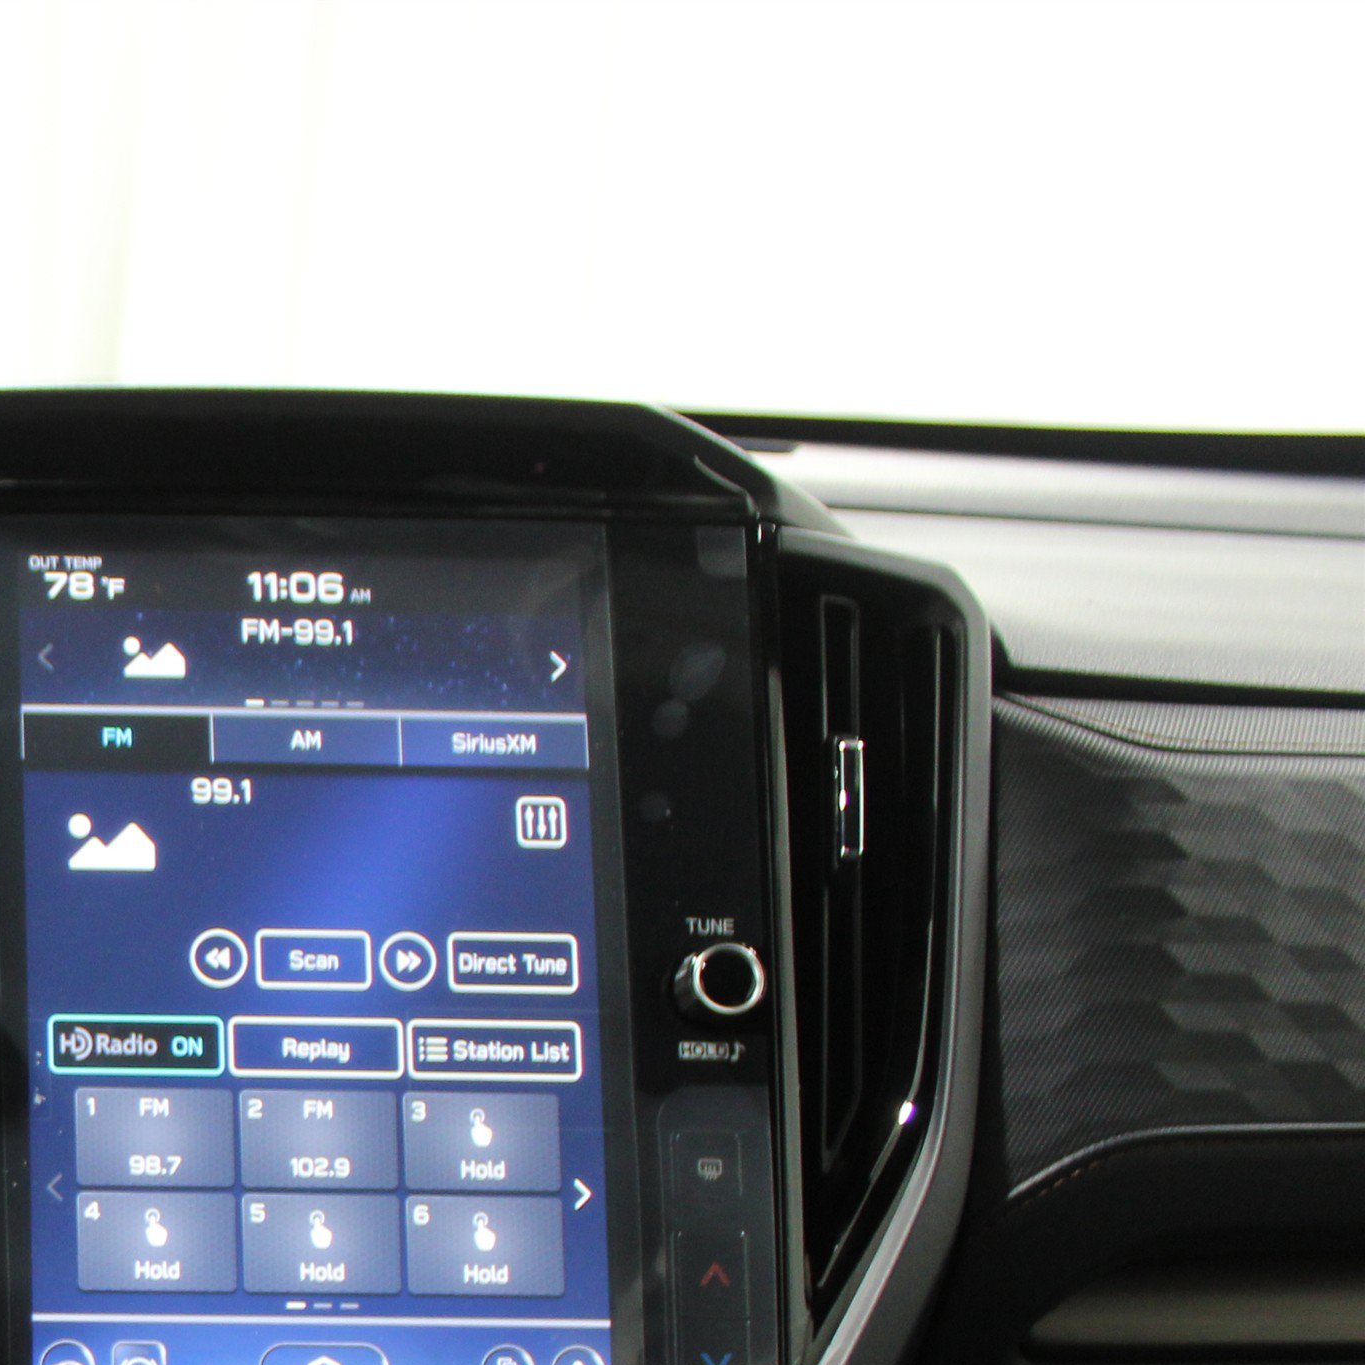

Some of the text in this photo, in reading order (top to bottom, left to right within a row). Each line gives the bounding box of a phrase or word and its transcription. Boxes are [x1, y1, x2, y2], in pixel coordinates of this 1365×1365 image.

[29, 556, 102, 569] OUT TEMP
[44, 571, 95, 600] 78
[247, 572, 371, 603] 11:06 AM
[242, 618, 354, 645] FM-99.1
[102, 728, 133, 748] FM
[290, 731, 322, 751] AM
[452, 733, 537, 754] SiriusXM
[191, 778, 252, 804] 99.1
[686, 917, 735, 936] TUNE
[289, 950, 339, 971] Scan
[458, 953, 568, 976] Direct Tune
[96, 1033, 158, 1056] Radio
[172, 1036, 203, 1057] ON
[282, 1038, 350, 1063] Replay
[454, 1040, 570, 1062] Station List
[86, 1097, 96, 1117] 1
[139, 1097, 170, 1117] FM
[247, 1098, 263, 1118] 2
[303, 1099, 333, 1119] FM
[411, 1101, 426, 1120] 3
[129, 1155, 181, 1177] 98.7
[290, 1157, 350, 1178] 102.9
[461, 1158, 505, 1180] Hold
[84, 1201, 100, 1220] 4
[249, 1203, 266, 1222] 5
[413, 1206, 429, 1225] 6
[135, 1260, 180, 1281] Hold
[300, 1261, 345, 1283] Hold
[464, 1263, 509, 1285] Hold
